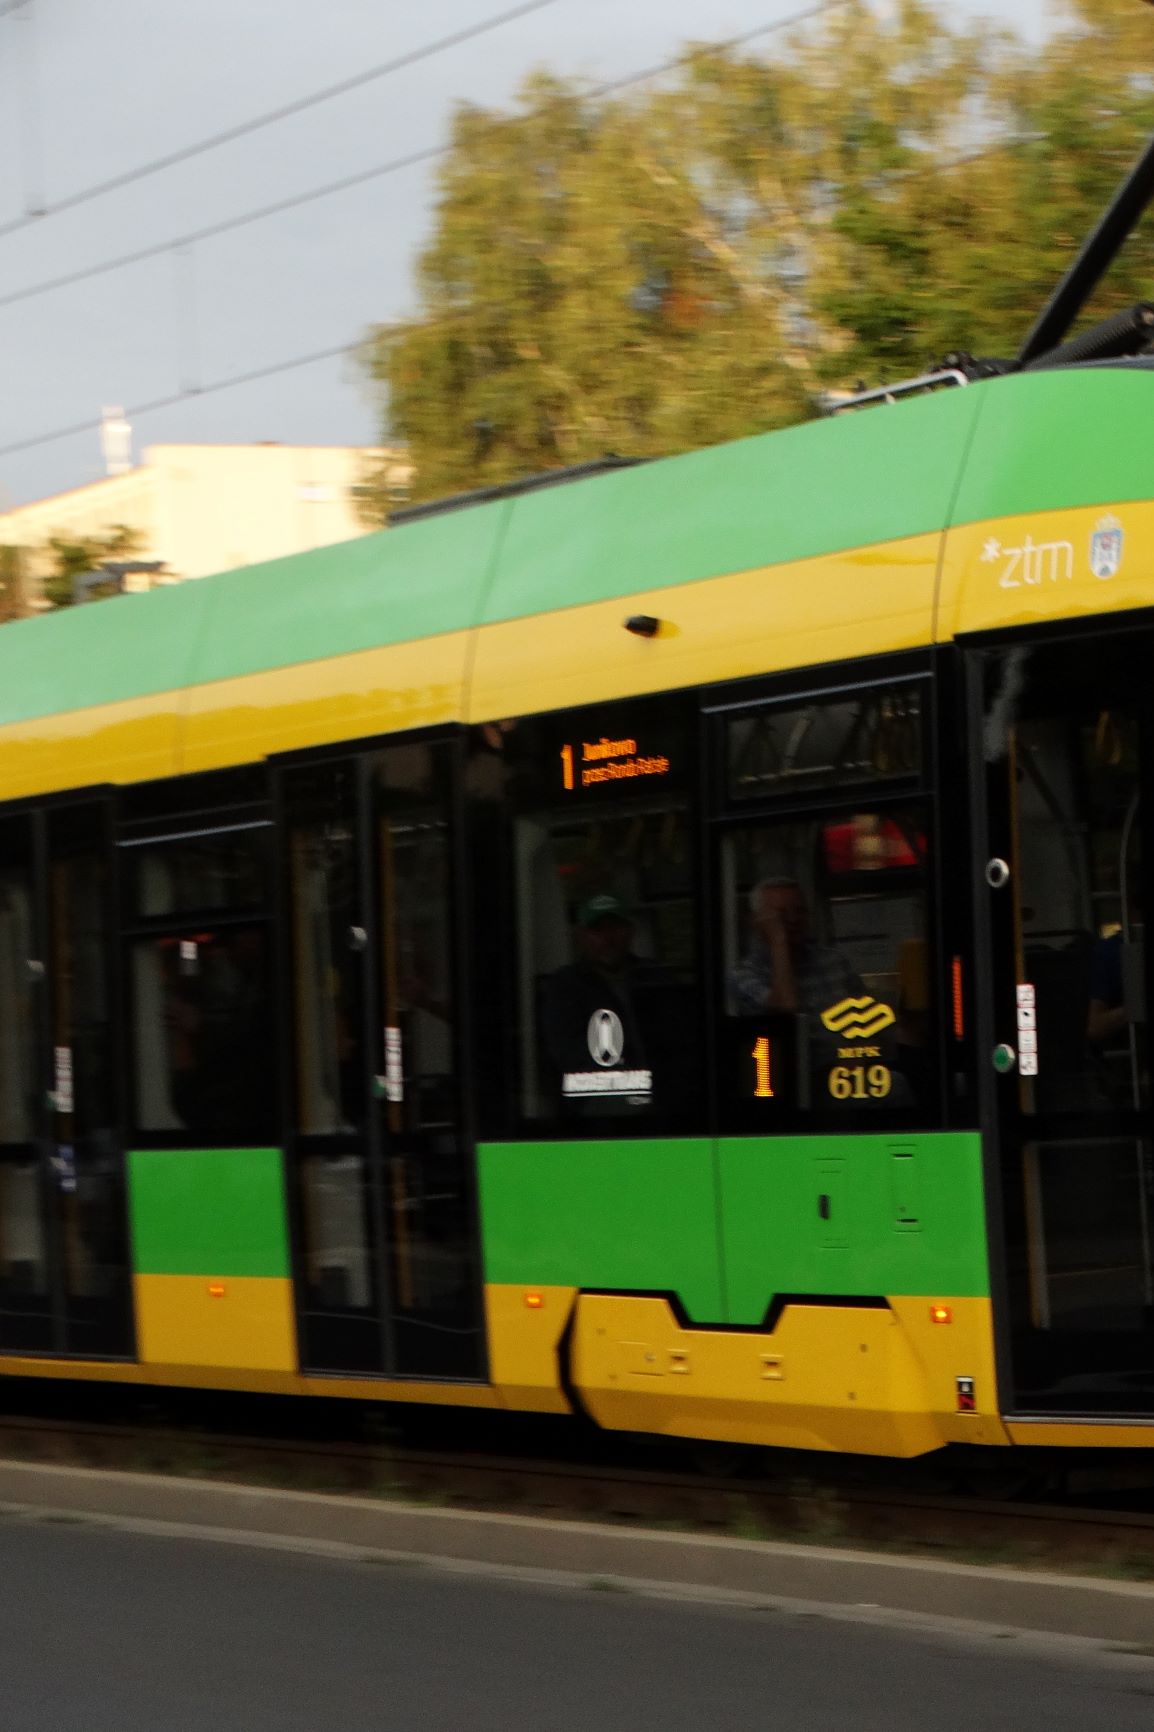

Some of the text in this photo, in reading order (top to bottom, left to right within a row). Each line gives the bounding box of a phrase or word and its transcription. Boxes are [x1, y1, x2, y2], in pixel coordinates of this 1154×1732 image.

[998, 533, 1073, 589] ztm
[560, 744, 574, 790] 1
[752, 1037, 774, 1097] 1
[828, 1064, 892, 1099] 619
